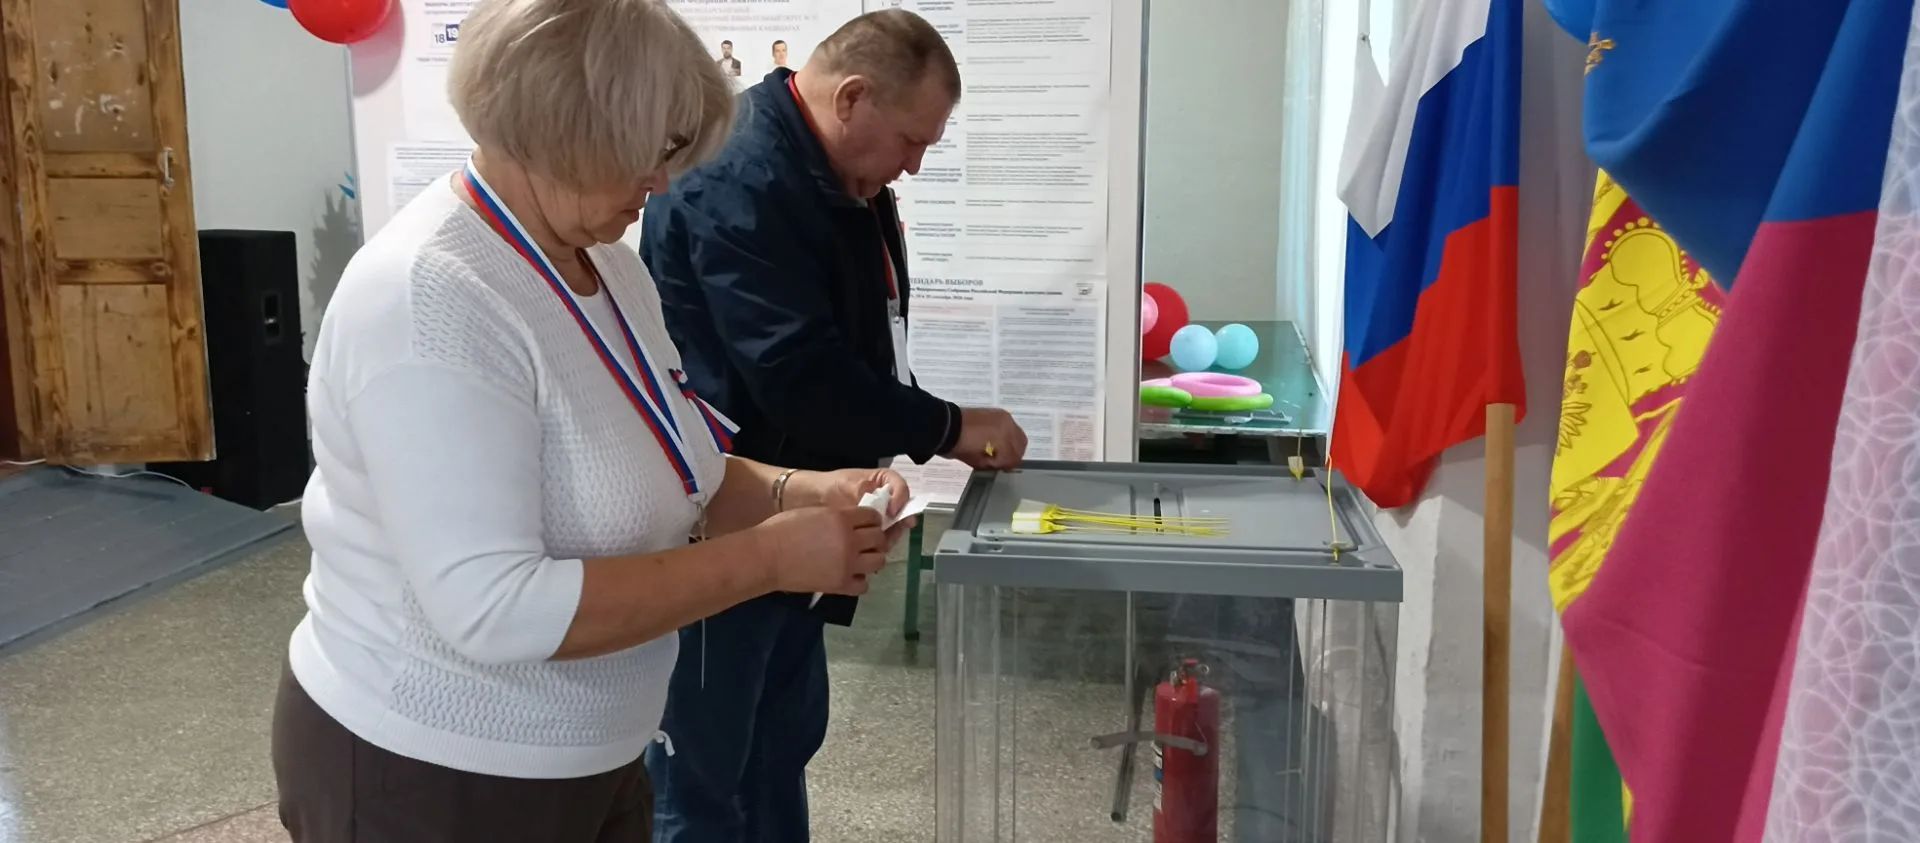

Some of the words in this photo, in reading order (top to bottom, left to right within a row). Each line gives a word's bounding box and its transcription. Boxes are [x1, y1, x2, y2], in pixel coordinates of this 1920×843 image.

[434, 33, 446, 44] 18
[446, 27, 459, 39] 19
[909, 277, 943, 285] ЛЕНДАРЬ
